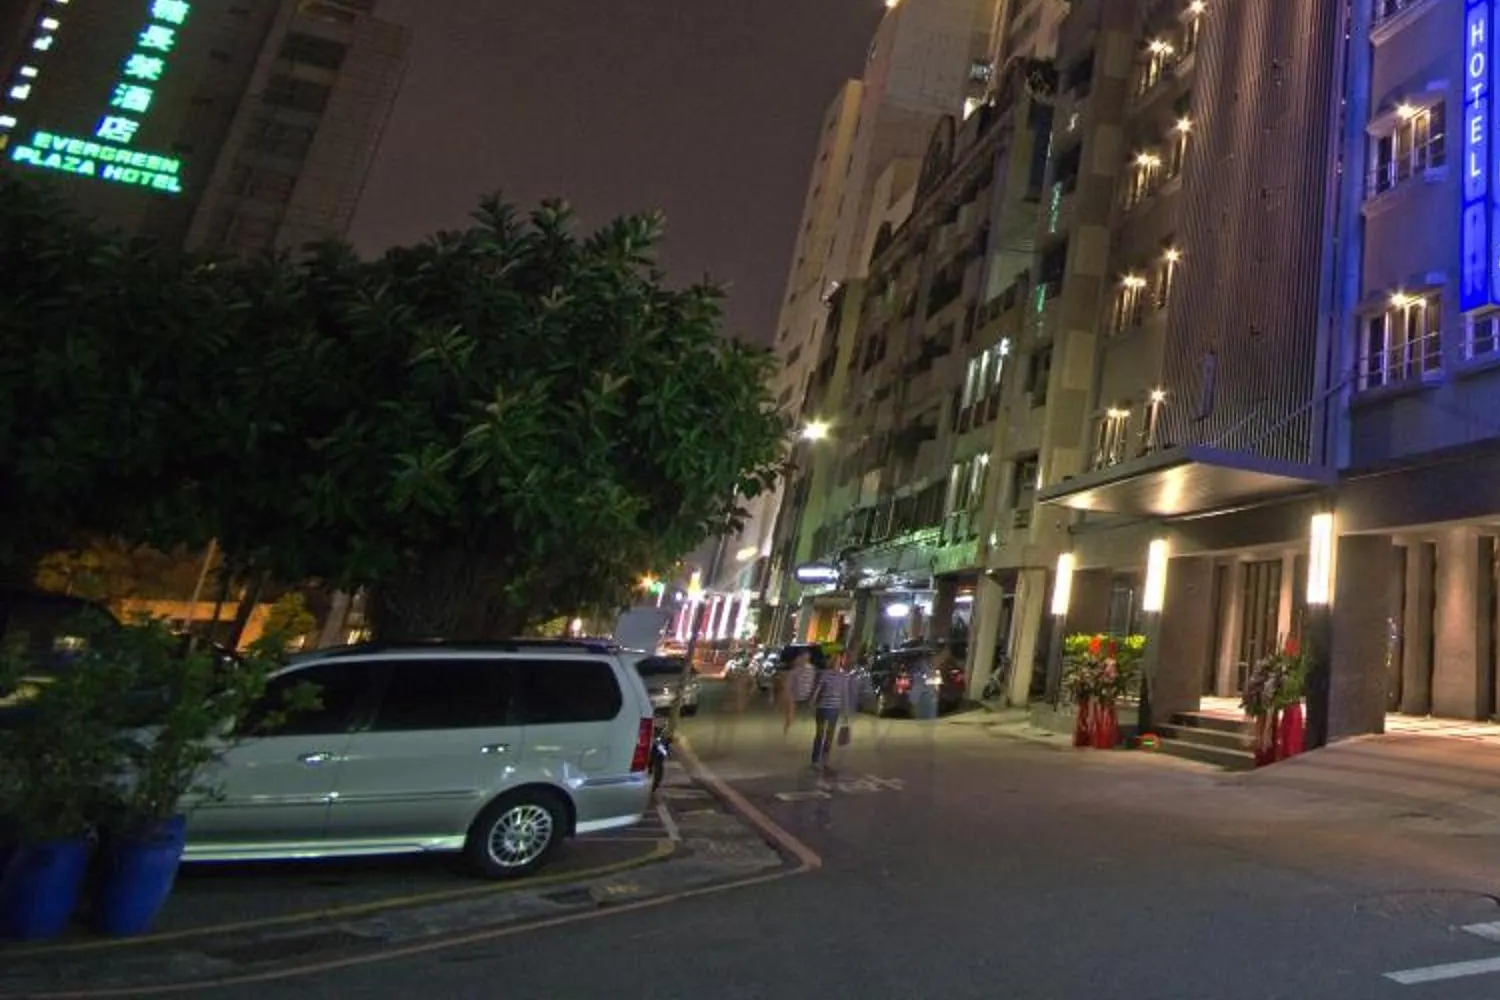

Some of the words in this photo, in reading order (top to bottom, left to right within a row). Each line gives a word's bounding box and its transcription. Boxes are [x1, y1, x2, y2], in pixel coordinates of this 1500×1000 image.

[1468, 18, 1486, 177] HOTEL
[12, 145, 96, 176] PLAZA
[103, 164, 182, 193] HOTEL
[33, 131, 180, 173] EVERGREEN
